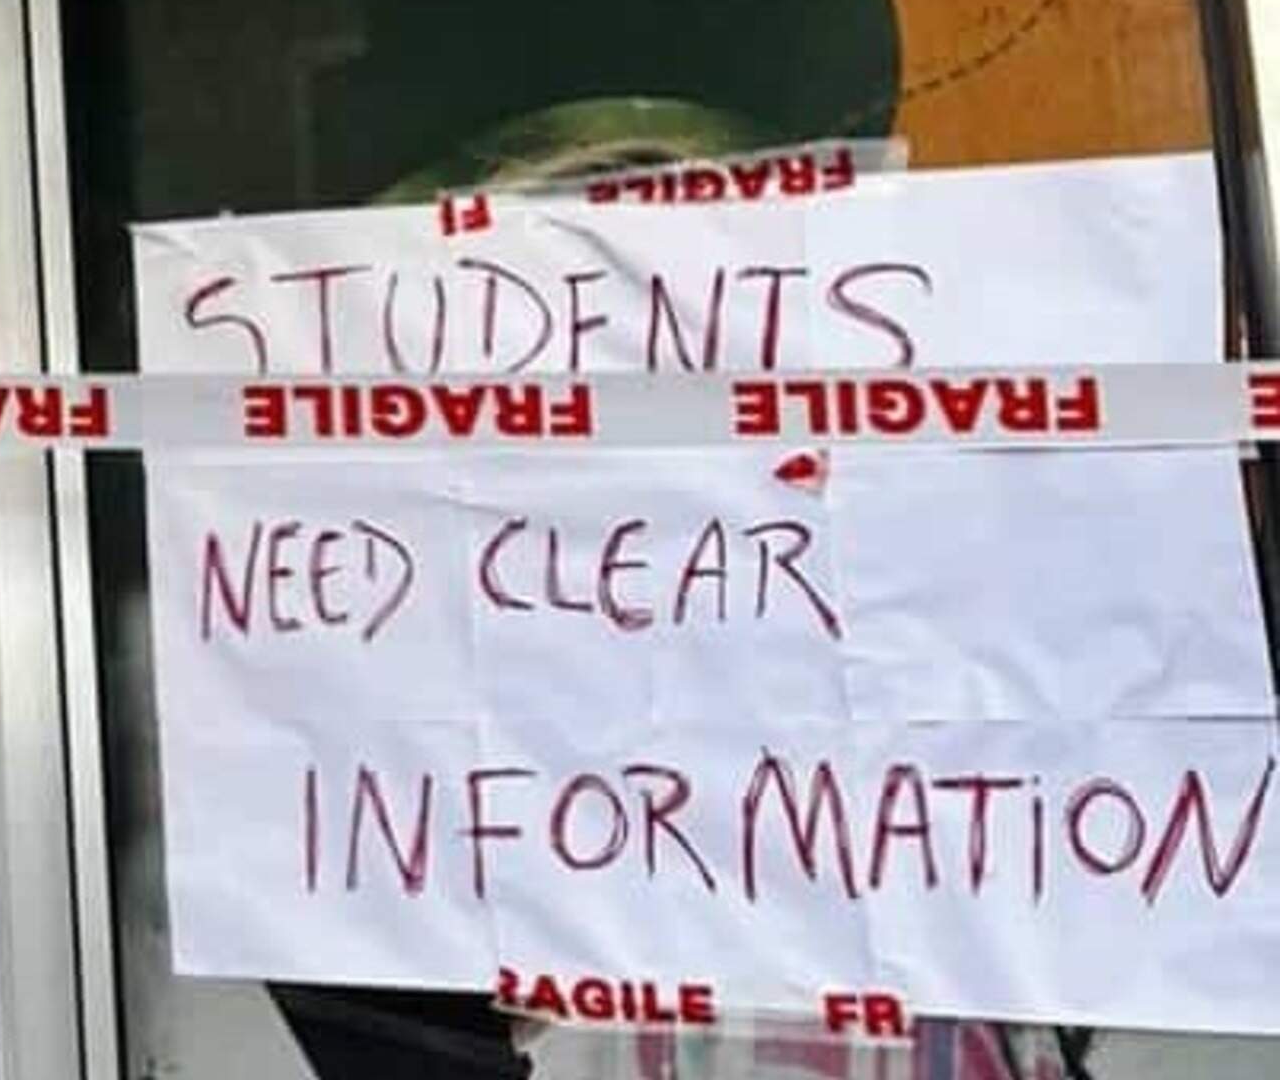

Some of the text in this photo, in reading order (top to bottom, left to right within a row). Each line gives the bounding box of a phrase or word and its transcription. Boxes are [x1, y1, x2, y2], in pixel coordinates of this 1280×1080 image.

[184, 258, 933, 375] STUDENTS
[244, 384, 593, 438] FRAGILE
[734, 378, 1099, 434] FRAGILE
[203, 520, 843, 642] NEED CLEAR
